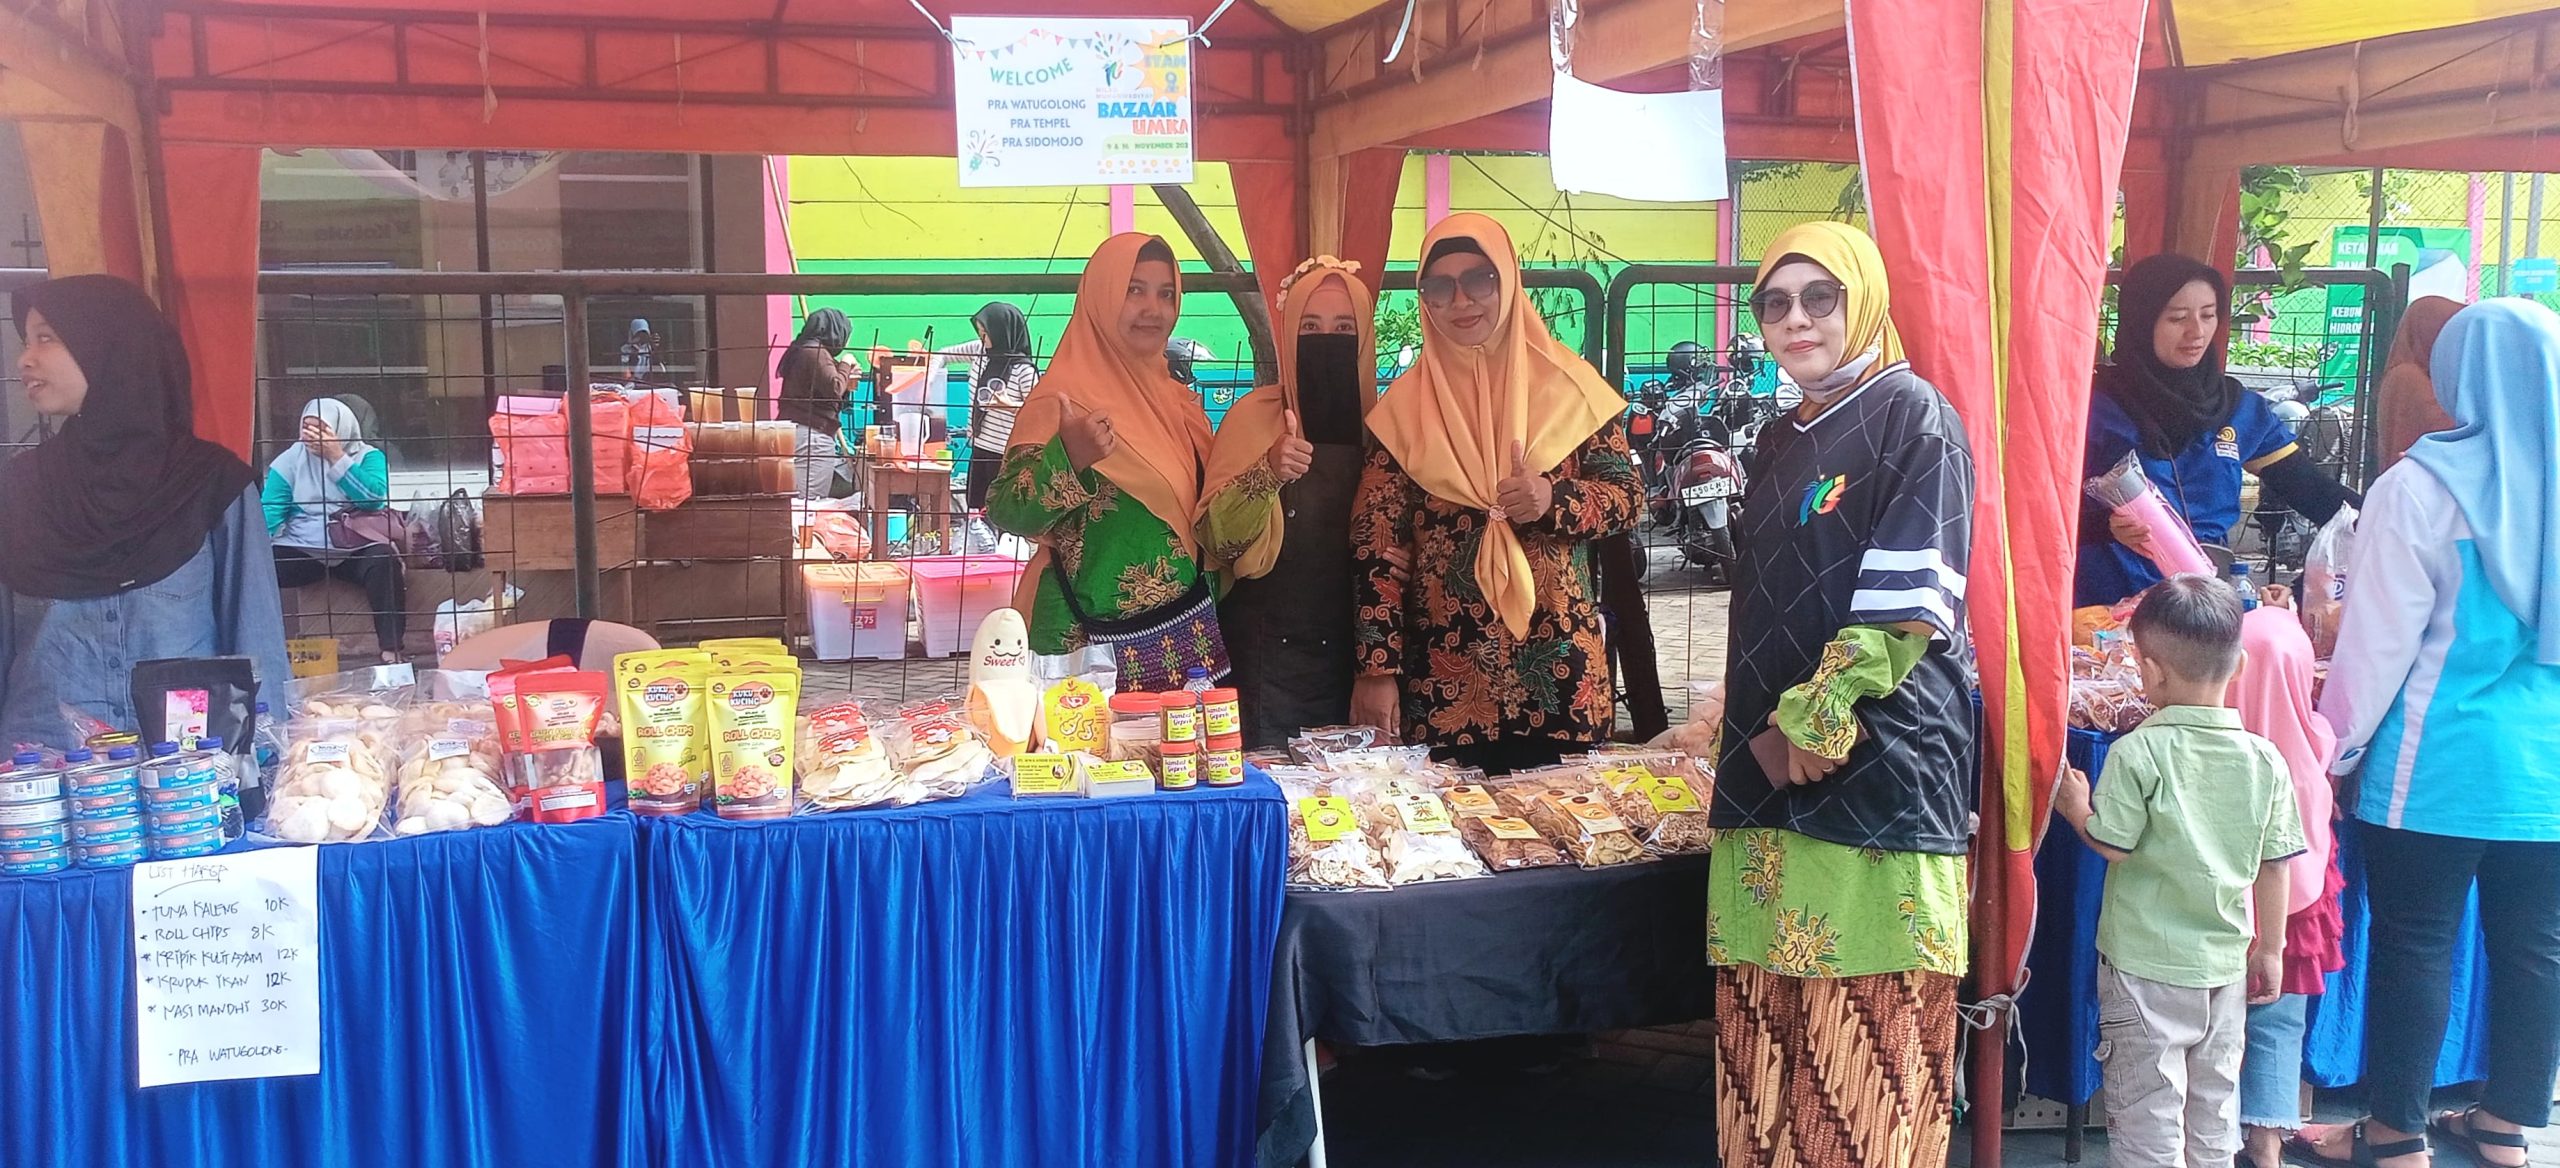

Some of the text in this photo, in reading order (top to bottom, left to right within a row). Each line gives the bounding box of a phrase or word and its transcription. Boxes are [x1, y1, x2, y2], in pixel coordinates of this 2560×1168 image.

[989, 57, 1074, 87] WELCOME
[988, 99, 1087, 110] PRA WATUGOLONG
[1097, 102, 1178, 119] BAZAAR
[1010, 117, 1071, 129] PRA TEMPEL
[1002, 136, 1084, 148] PRA SIDOMOJO
[984, 655, 1017, 666] Sweet
[636, 724, 694, 738] ROLL CHIPS
[723, 727, 781, 743] ROLL CHIPS
[152, 896, 290, 921] TUNA KALENG 10K
[155, 923, 276, 942] ROLL CHIPS 8K
[156, 948, 300, 969] KRIPIK KULIT AYAM 12K
[157, 972, 293, 993] KRUPUK IKAN 12K
[163, 998, 289, 1020] NASI MANDHI 30K
[178, 1048, 200, 1066] PRA
